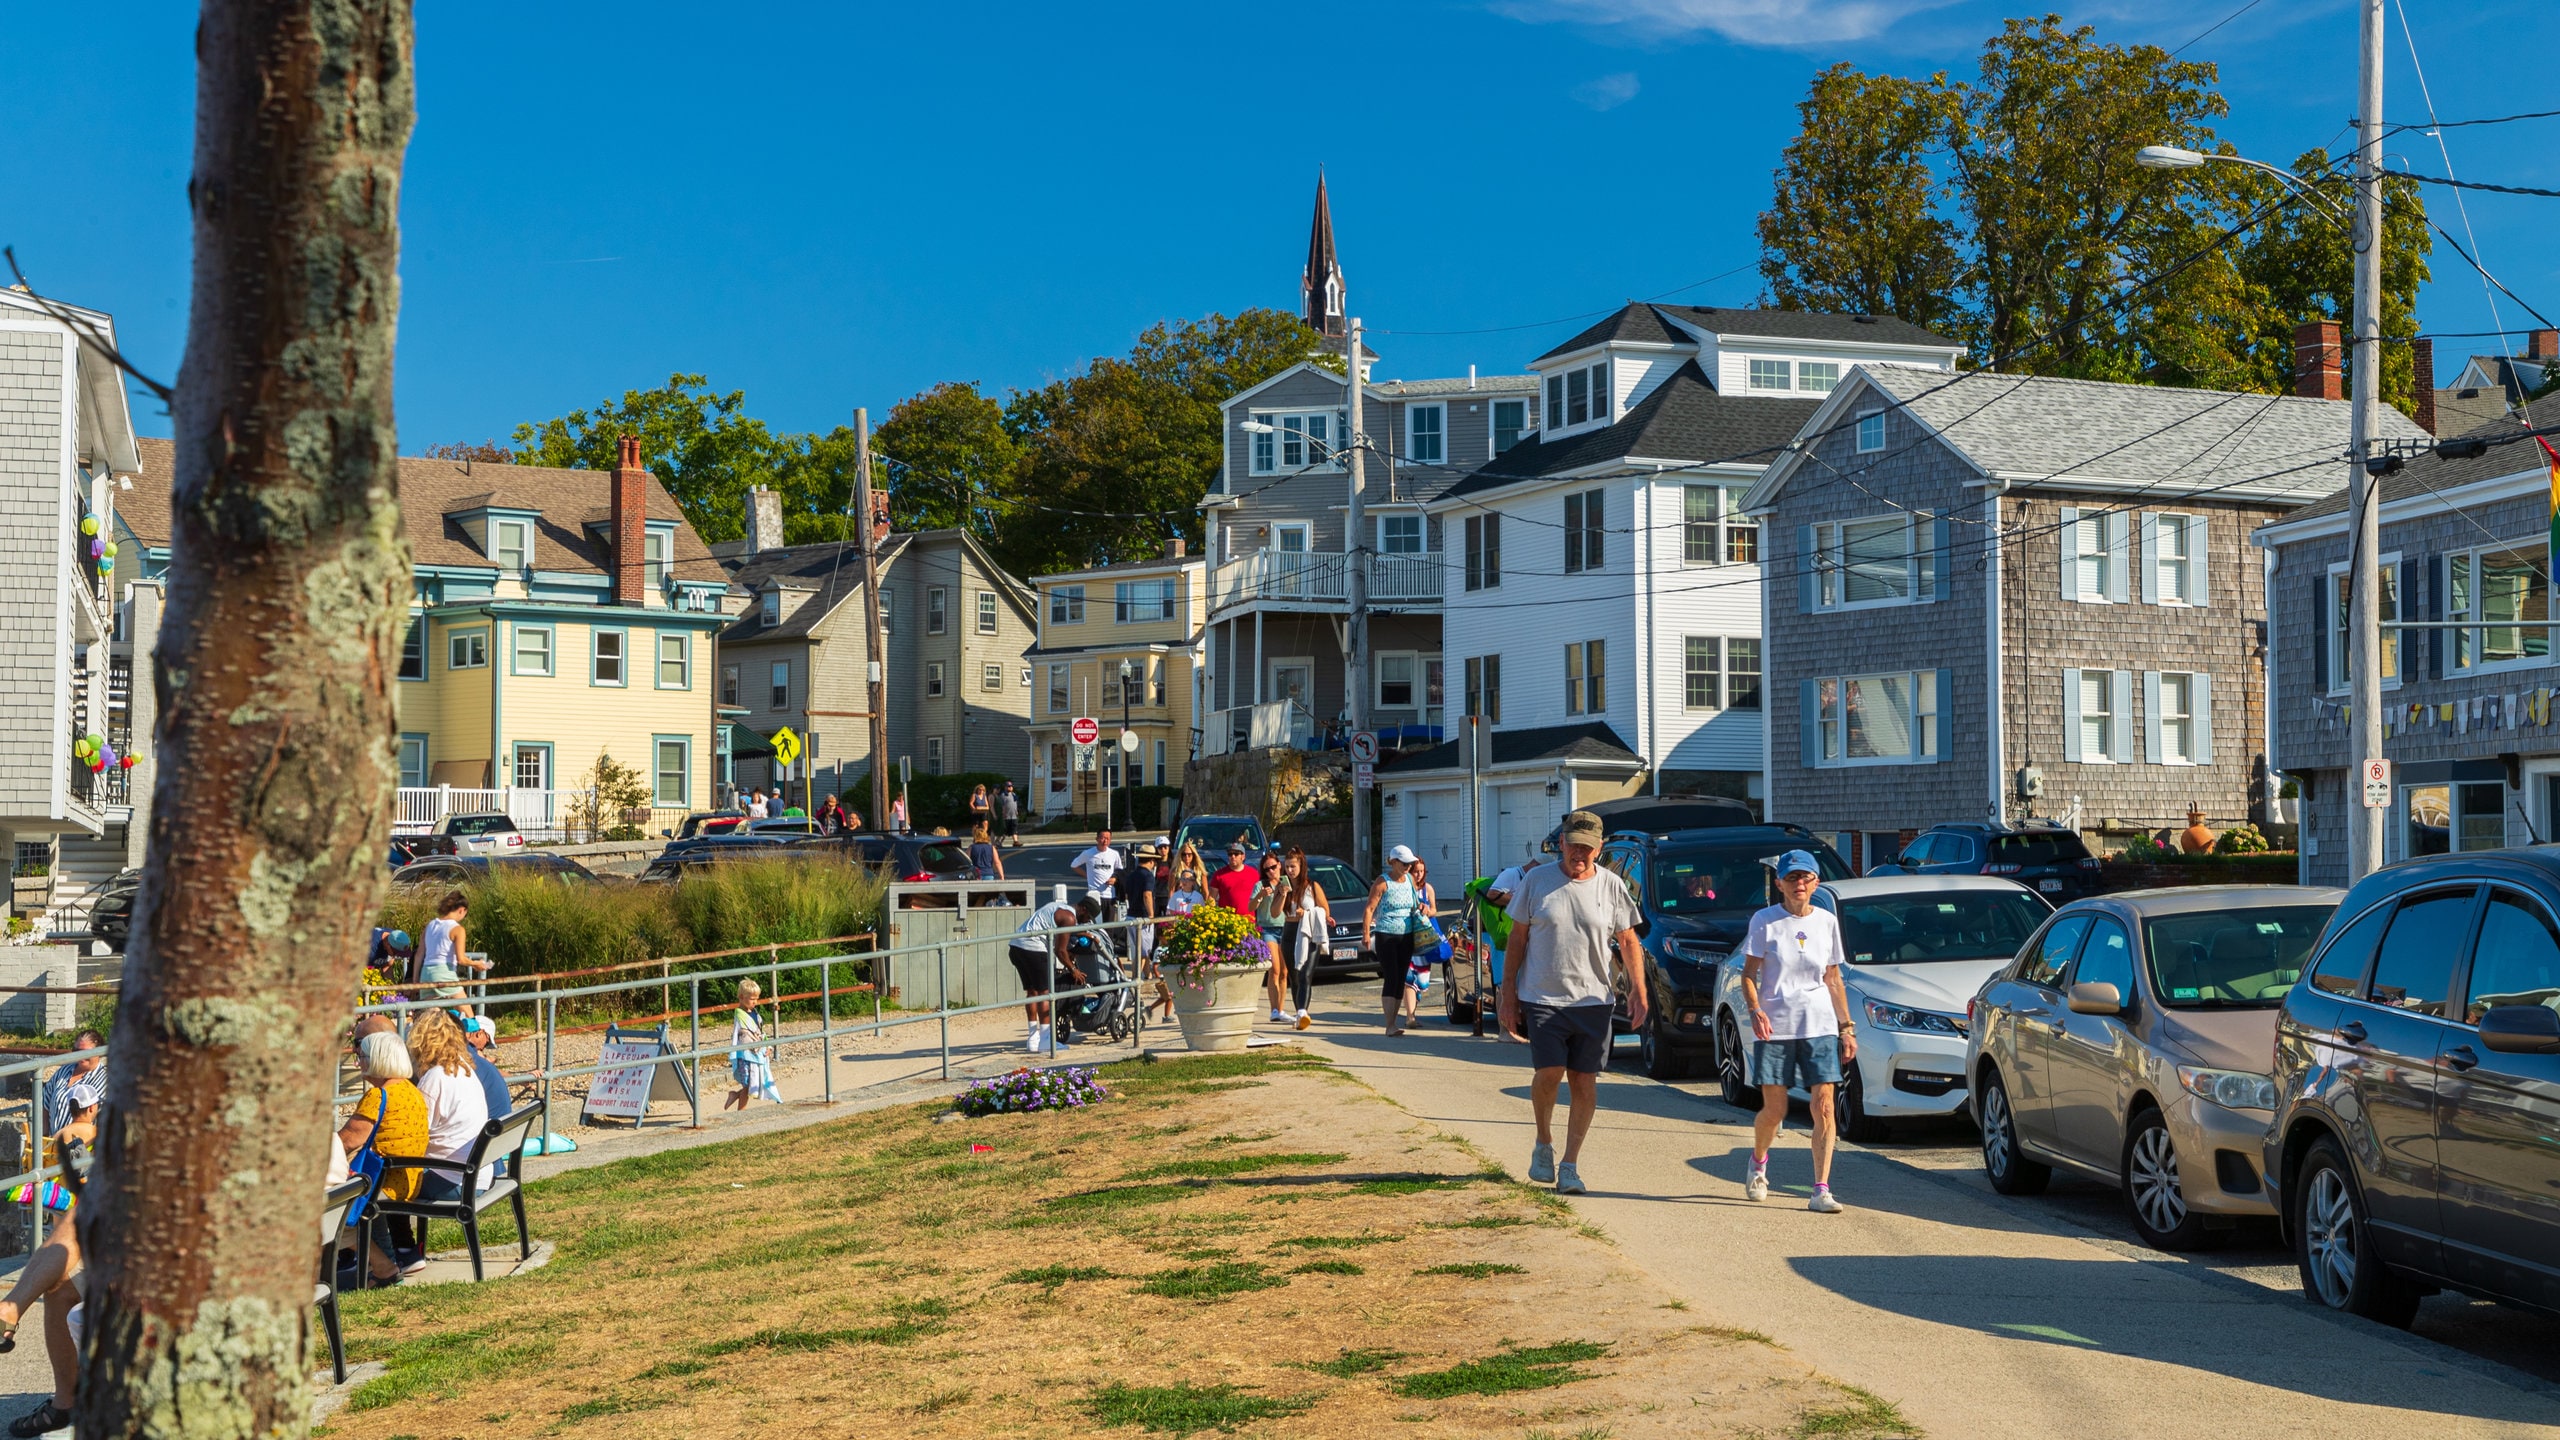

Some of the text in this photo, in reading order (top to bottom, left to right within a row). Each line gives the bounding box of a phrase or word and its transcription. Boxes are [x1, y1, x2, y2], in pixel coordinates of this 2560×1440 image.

[1077, 762, 1093, 770] ONLY
[1987, 801, 1996, 816] 6
[605, 1051, 649, 1060] LIFEGUARD
[597, 1076, 643, 1086] YOUR OWN
[608, 1086, 630, 1095] RISK
[589, 1098, 639, 1108] ROCKPORT POLICE
